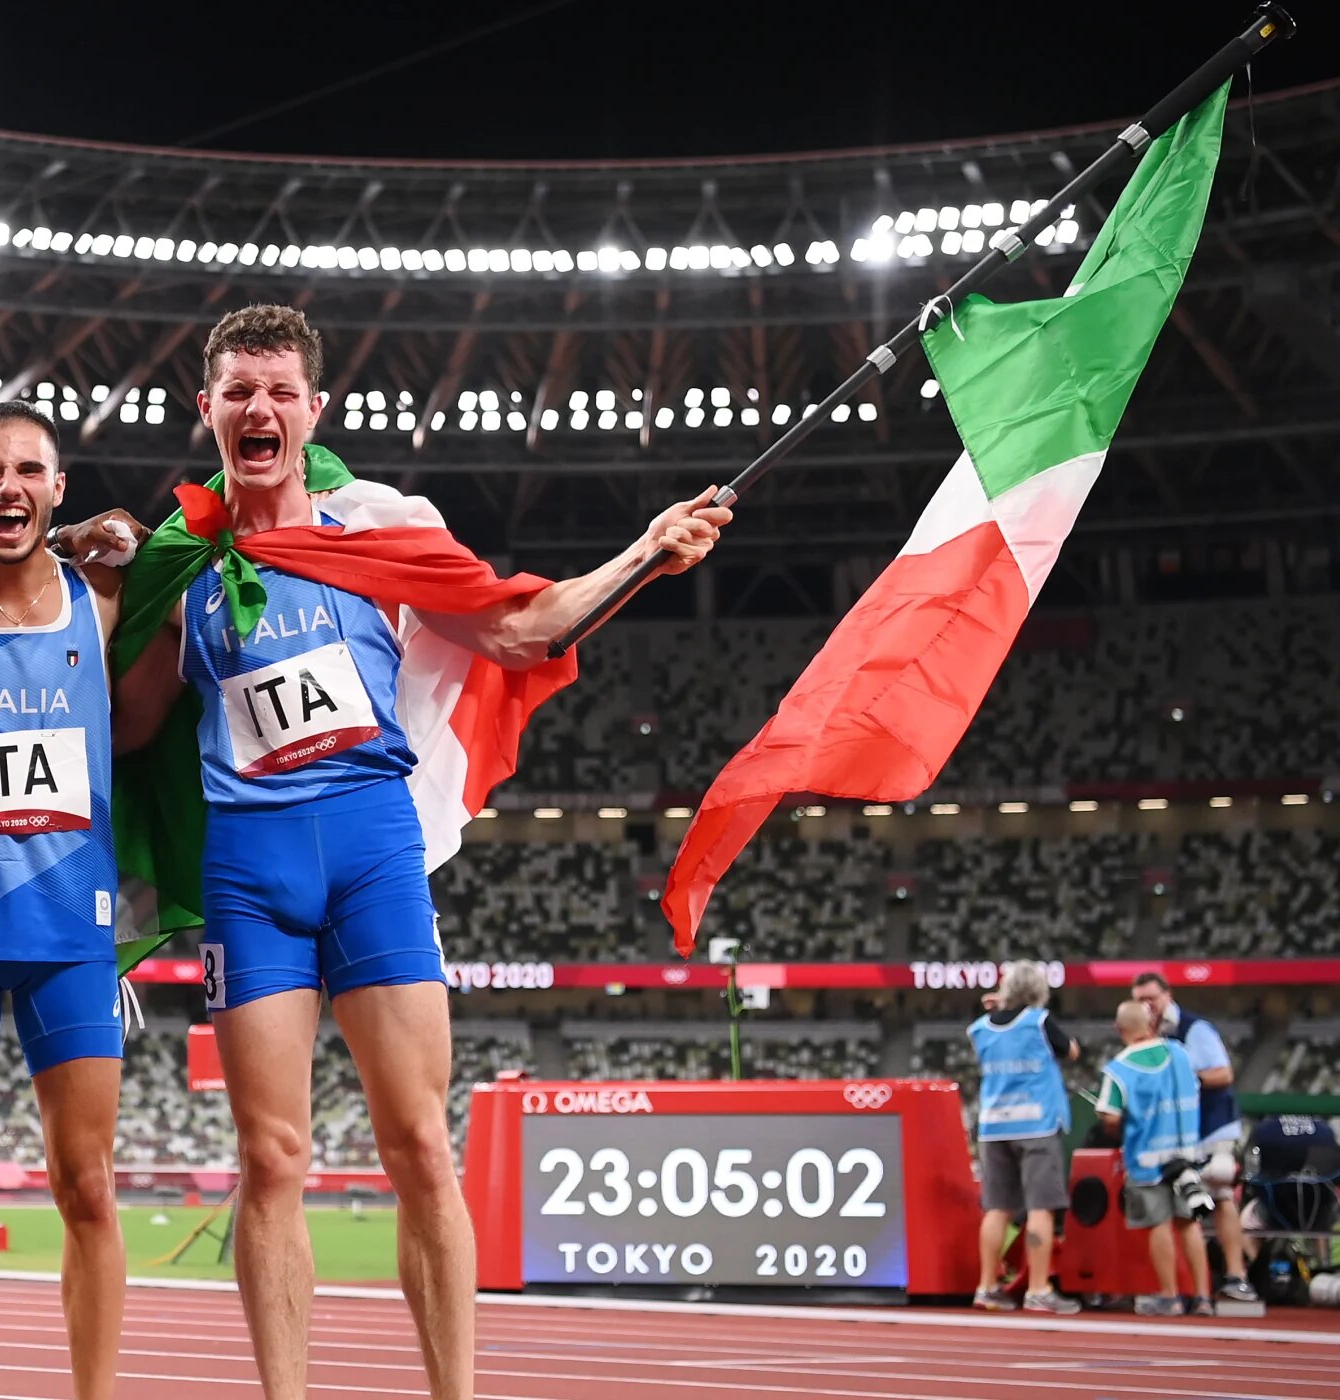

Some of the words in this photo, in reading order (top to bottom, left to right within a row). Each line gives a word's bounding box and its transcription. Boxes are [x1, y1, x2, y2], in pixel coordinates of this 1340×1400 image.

[243, 667, 339, 738] ITA
[276, 751, 298, 765] TOKYO
[297, 745, 316, 758] 2020
[10, 818, 28, 827] 2020
[491, 961, 555, 989] 2020
[910, 960, 998, 989] TOKYO
[554, 1091, 654, 1114] OMEGA
[539, 1147, 887, 1218] 23:05:02
[558, 1242, 713, 1275] TOKYO
[755, 1244, 867, 1278] 2020
